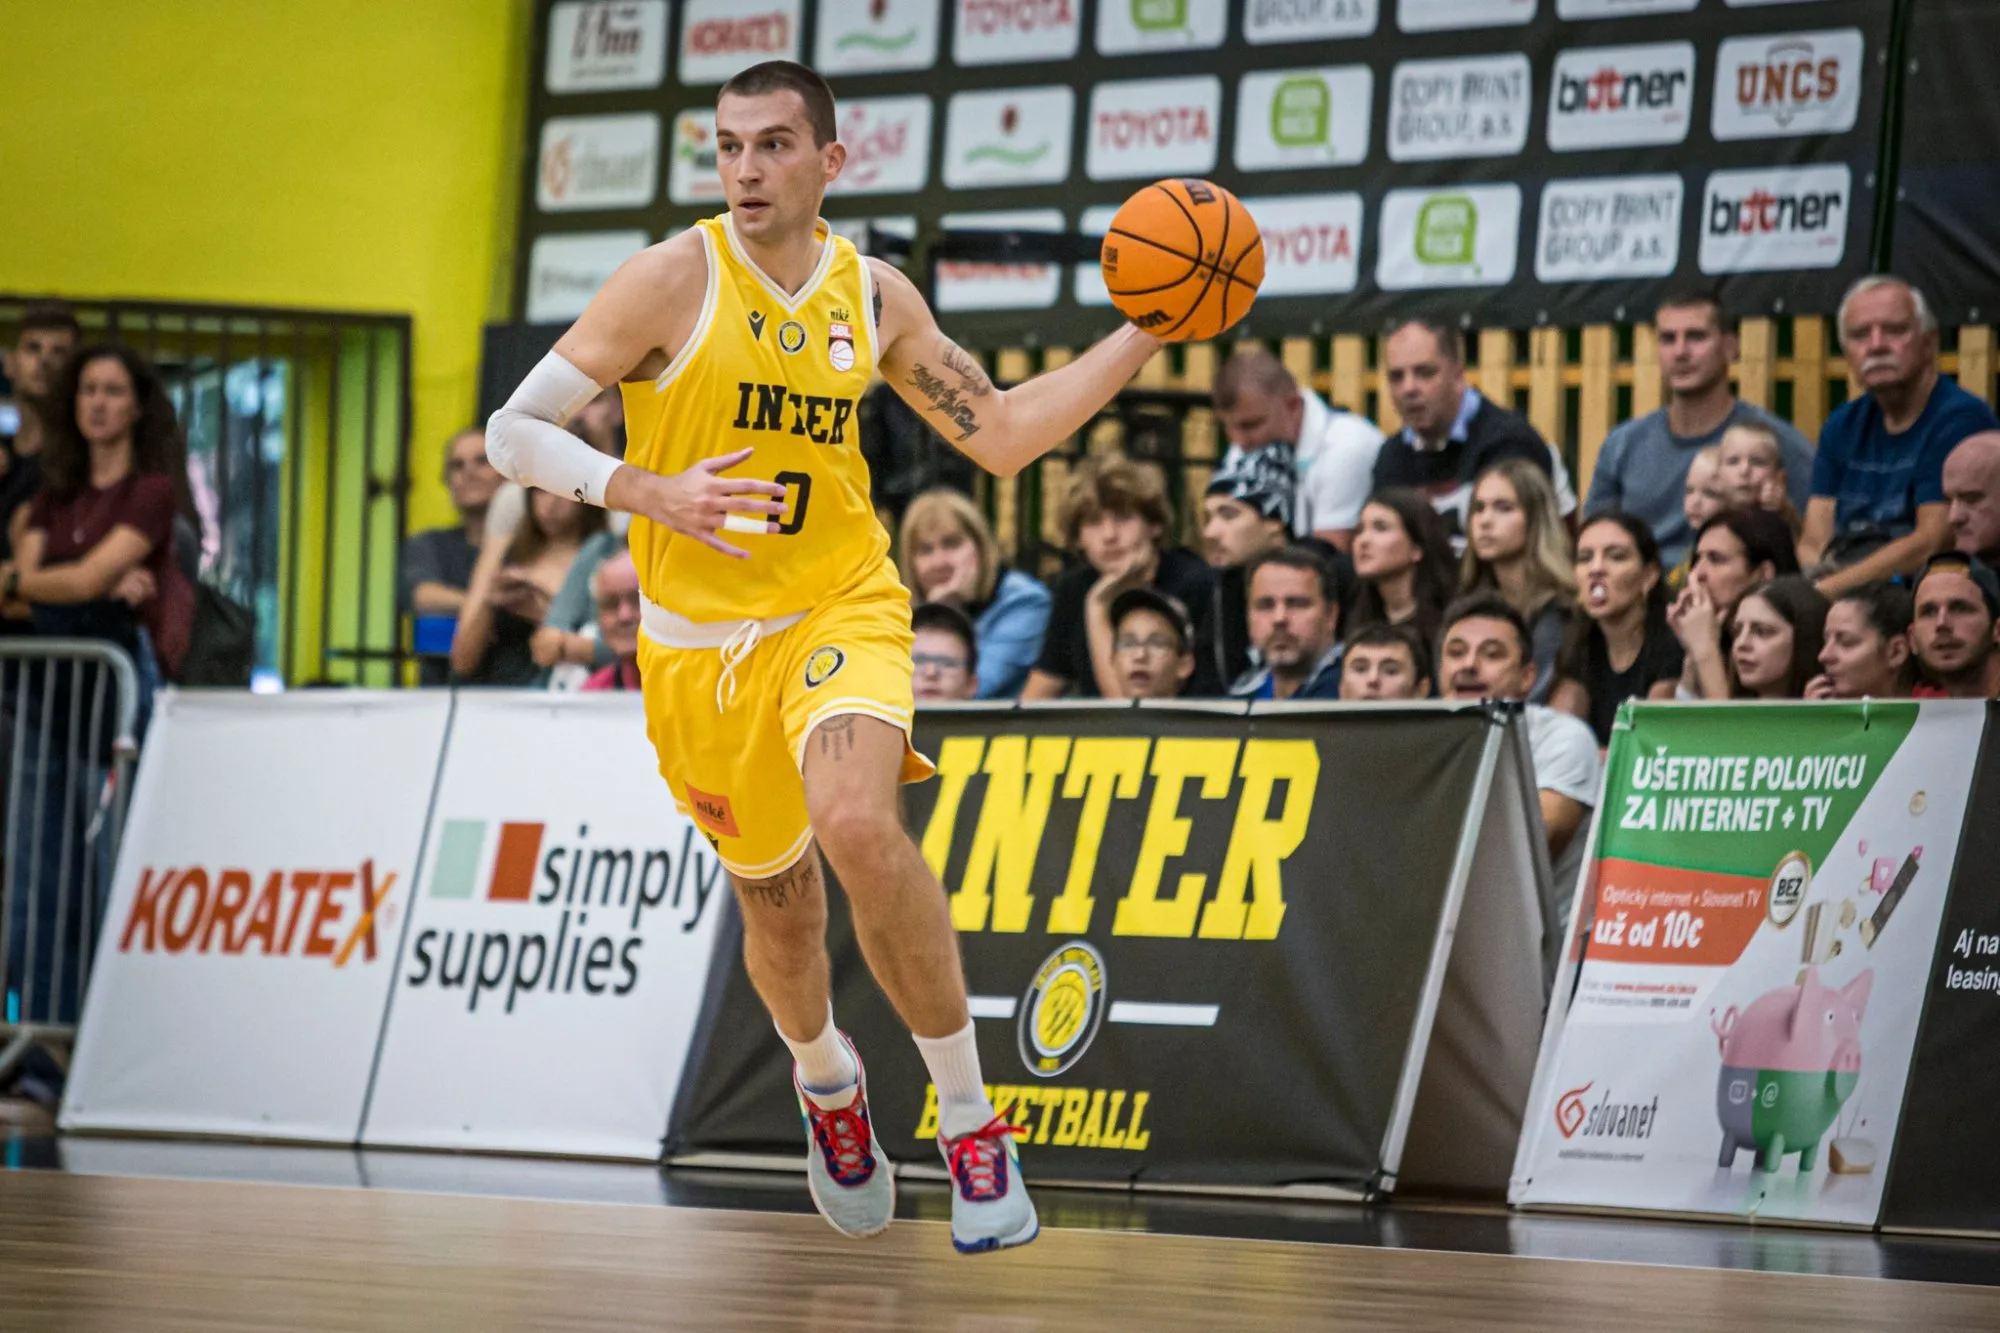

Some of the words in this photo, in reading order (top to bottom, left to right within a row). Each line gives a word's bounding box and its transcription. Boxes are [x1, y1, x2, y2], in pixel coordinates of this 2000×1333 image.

[1737, 58, 1840, 107] UNCS
[1097, 106, 1210, 149] TOYOTA
[830, 325, 852, 338] SBL
[733, 382, 853, 444] INTER
[1632, 746, 1749, 791] UŠETRITE
[1751, 754, 1867, 791] POLOVICU
[1620, 795, 1657, 830] ZA
[1662, 795, 1781, 832] INTERNET
[1802, 796, 1833, 832] TV
[920, 736, 1320, 940] INTER
[538, 824, 721, 933] simply
[1777, 877, 1802, 897] BEZ
[119, 859, 397, 968] KORATEX
[1595, 911, 1628, 945] už
[1628, 917, 1658, 948] od
[1662, 909, 1704, 949] 10€
[408, 909, 643, 1013] supplies
[1953, 928, 1975, 959] Aj
[1946, 963, 2000, 996] leasin
[914, 1084, 1150, 1150] BKETBALL
[1583, 1089, 1658, 1139] slovanet
